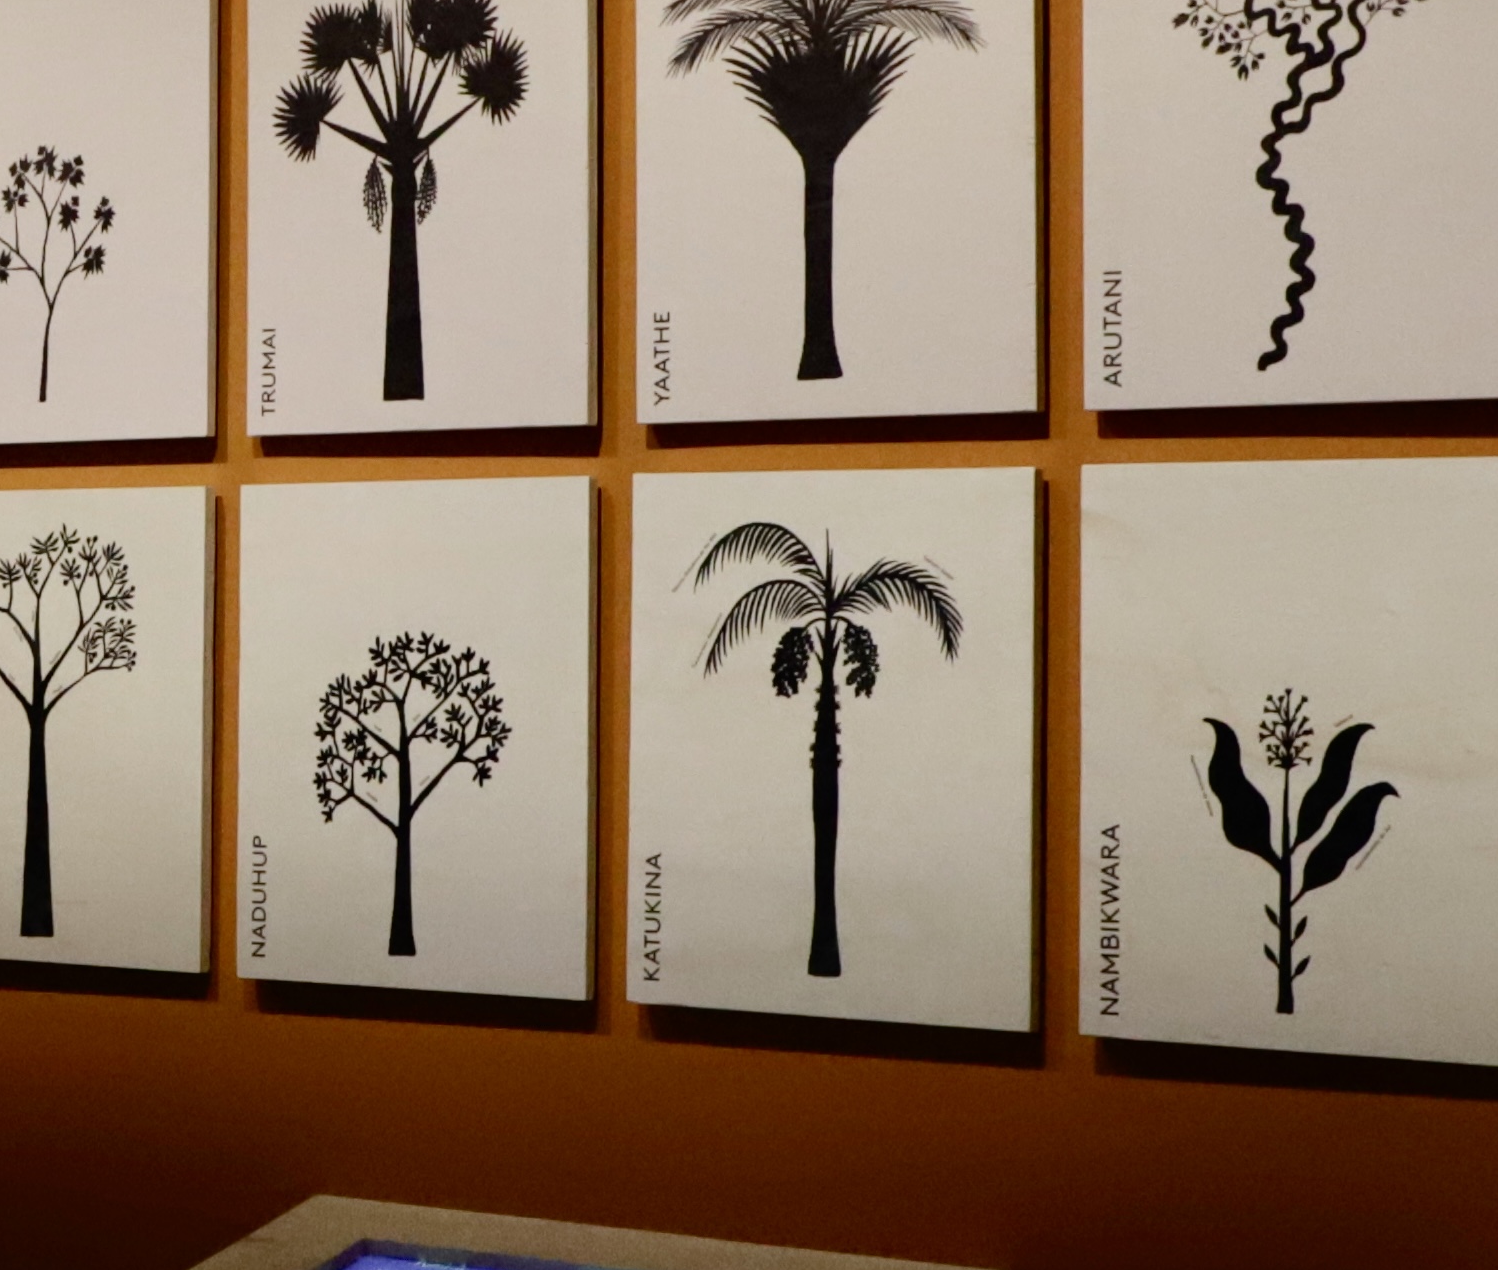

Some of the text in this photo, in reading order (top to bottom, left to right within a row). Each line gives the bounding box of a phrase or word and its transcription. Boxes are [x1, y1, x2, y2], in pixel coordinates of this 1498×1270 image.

[261, 328, 277, 417] TRUMAI
[653, 312, 671, 406] YAATHE
[1102, 270, 1123, 388] ARUTANI
[251, 835, 267, 959] NADUHUP
[643, 853, 662, 982] KATUKINA
[1100, 824, 1120, 1017] NAMBIKWARA
